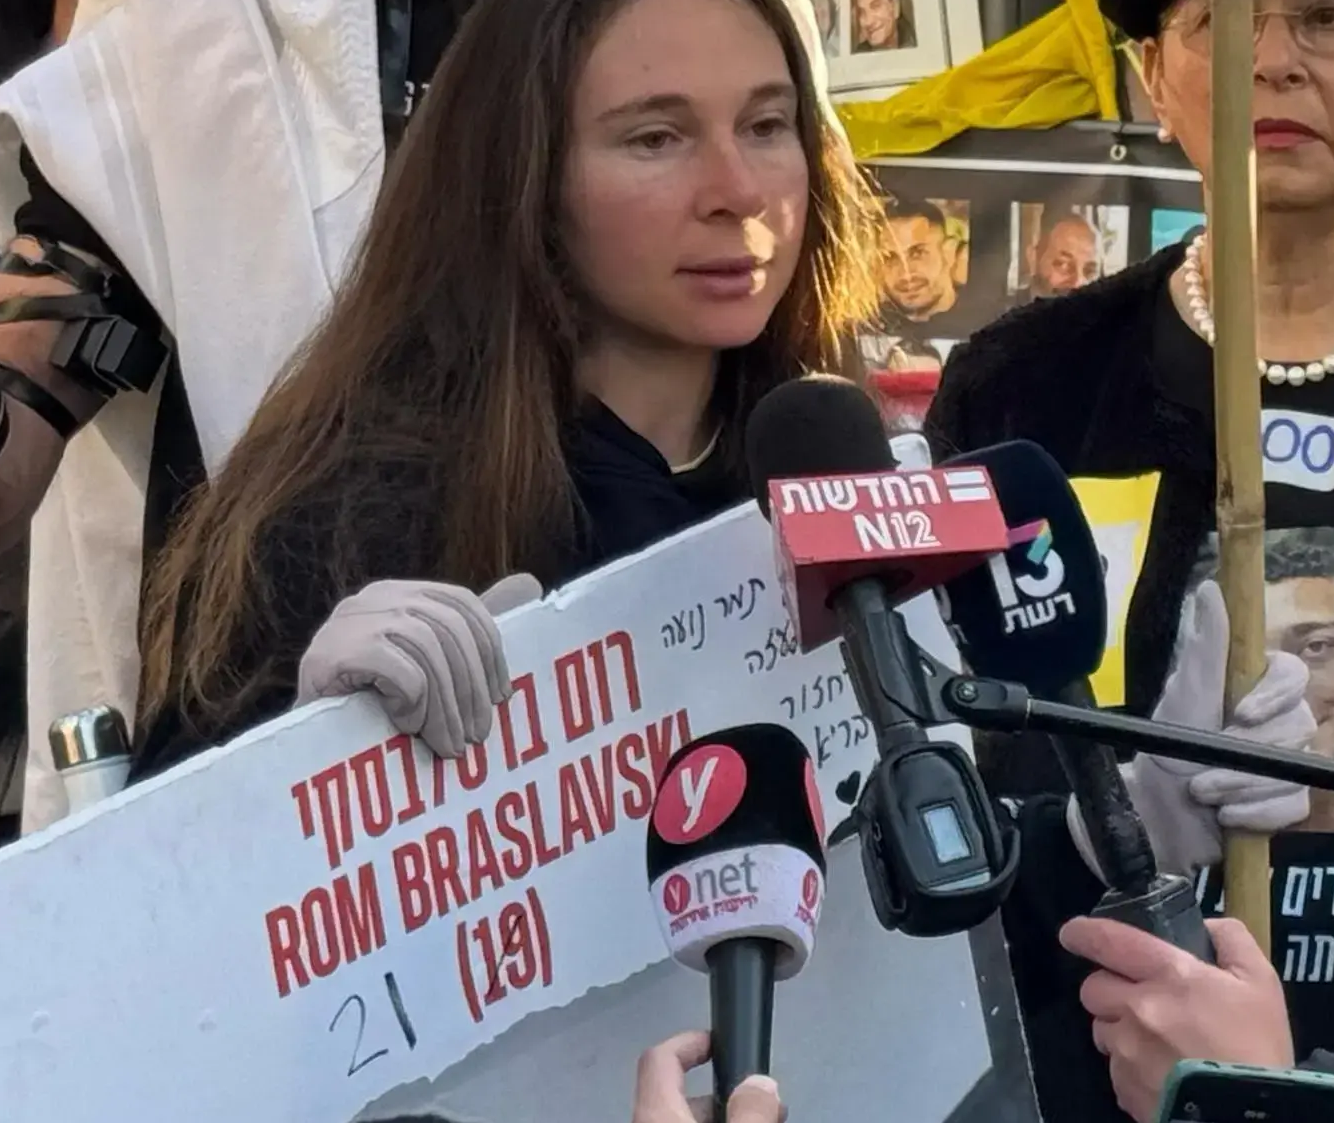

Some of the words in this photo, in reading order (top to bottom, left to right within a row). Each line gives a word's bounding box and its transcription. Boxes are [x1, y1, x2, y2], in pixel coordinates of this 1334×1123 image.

[780, 474, 942, 515] החדשות
[853, 510, 943, 553] N12
[1004, 592, 1076, 633] רשת
[554, 630, 641, 742] רום
[780, 669, 848, 719] חזור
[265, 861, 386, 999] ROM
[456, 886, 553, 1024] (19)
[328, 971, 417, 1077] 21
